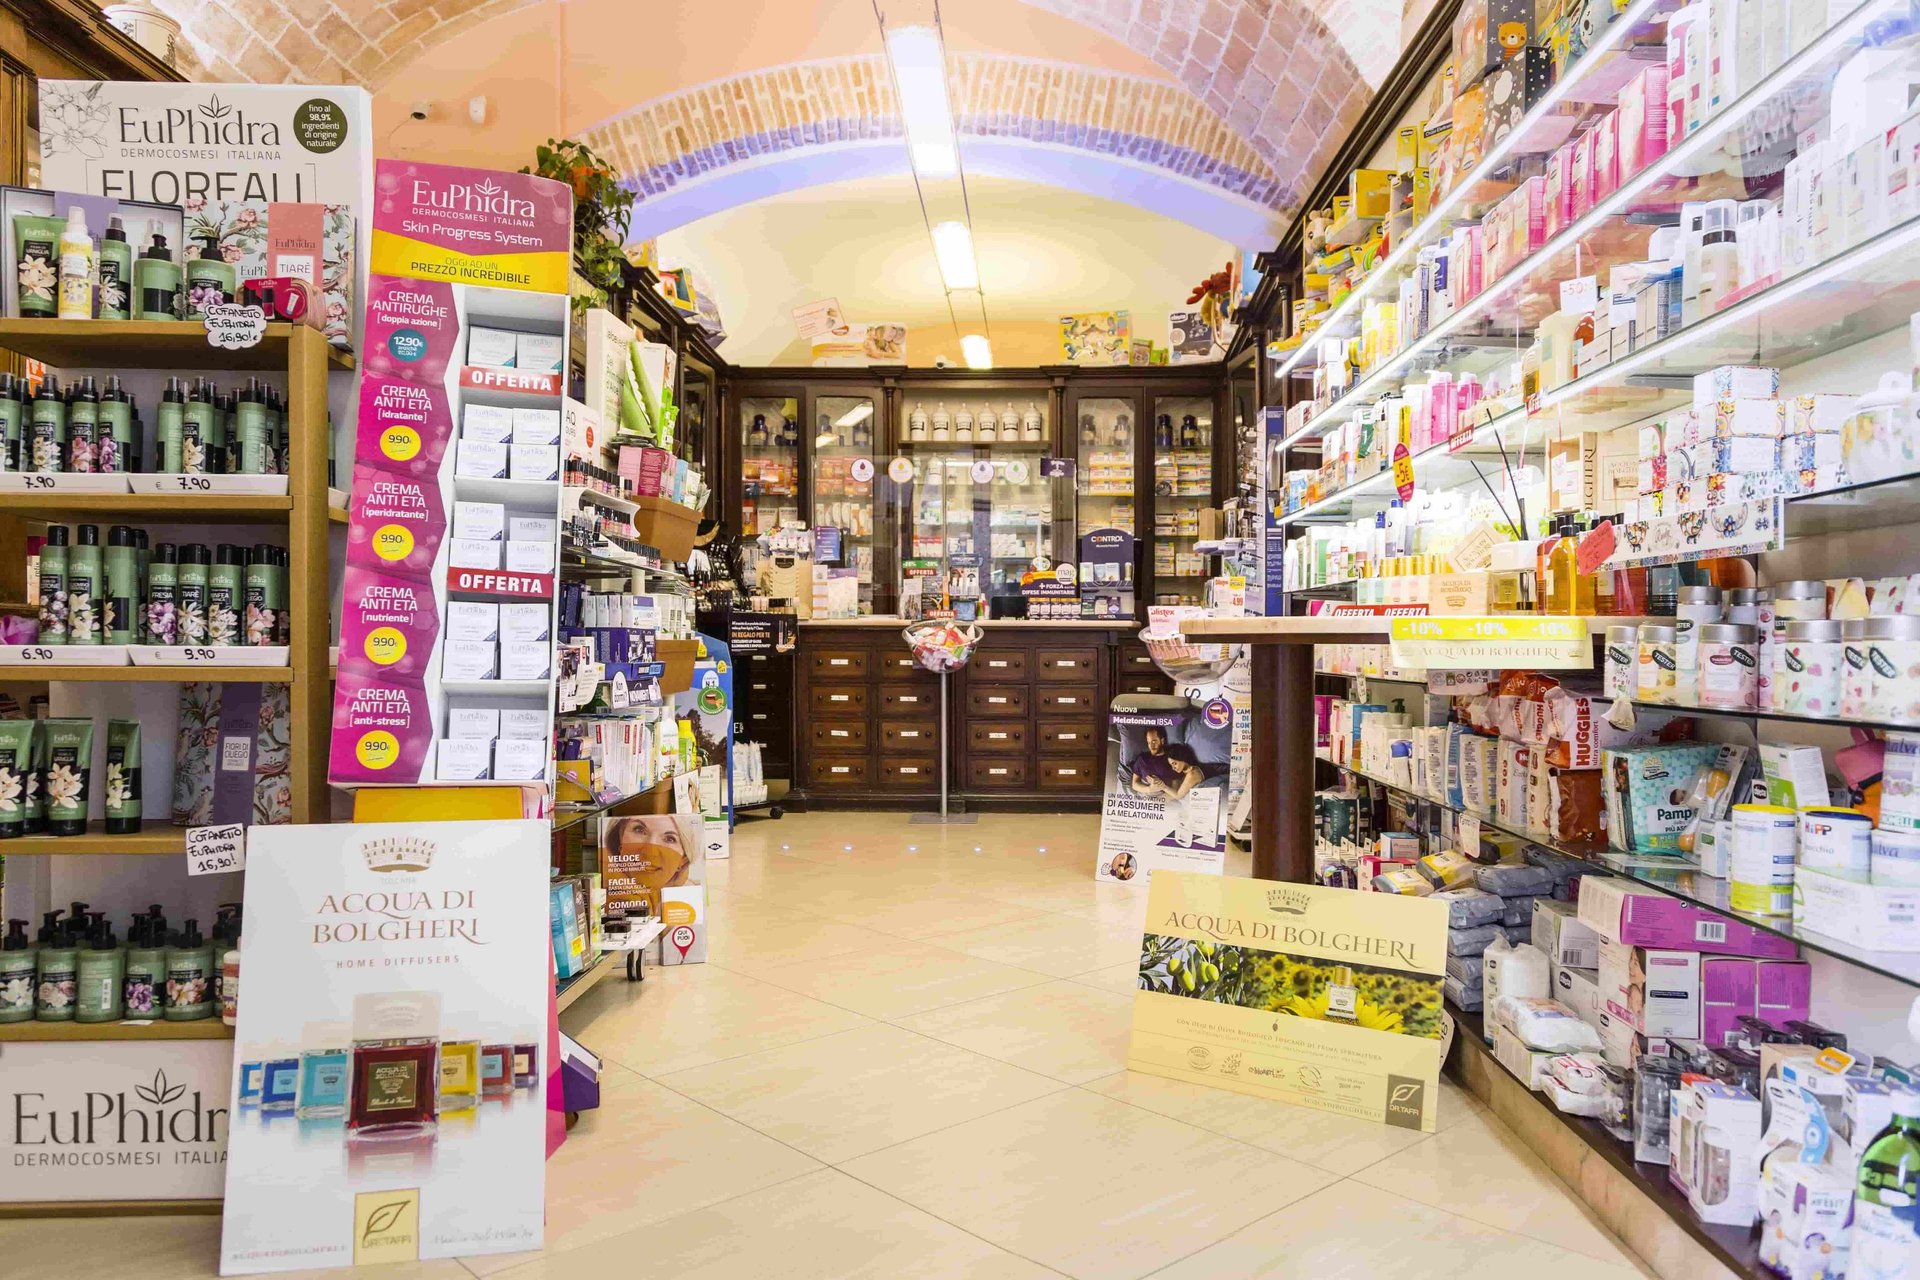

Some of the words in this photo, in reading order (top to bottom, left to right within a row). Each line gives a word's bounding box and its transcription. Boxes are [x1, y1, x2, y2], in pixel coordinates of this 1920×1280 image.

[118, 106, 281, 146] EuPhidra
[302, 122, 339, 131] ingredienti
[313, 131, 337, 140] origine
[121, 148, 219, 159] DERMOCOSMESI
[228, 150, 281, 161] ITALIANA
[412, 180, 536, 218] EuPhidra
[412, 207, 488, 222] DERMOCOSMESI
[493, 216, 535, 228] ITALIANA
[402, 220, 430, 233] Skin
[433, 224, 492, 241] Progress
[495, 230, 543, 247] System
[279, 263, 311, 274] TIARÈ
[411, 261, 457, 276] PREZZO
[460, 268, 531, 285] INCREDIBILE
[388, 291, 434, 305] CREMA
[372, 300, 448, 318] ANTIRUGHE
[471, 370, 552, 391] OFFERTA
[381, 385, 427, 398] CREMA
[374, 397, 407, 409] ANTI
[374, 482, 420, 496] CREMA
[366, 495, 400, 505] ANTI
[459, 573, 543, 594] OFFERTA
[365, 586, 413, 599] CREMA
[358, 598, 392, 610] ANTI
[1334, 608, 1374, 616] OFFERTA
[1384, 608, 1428, 616] OFFERTA
[1402, 622, 1444, 636] -10%
[1468, 622, 1507, 636] -10%
[1609, 647, 1631, 665] TESTER
[1733, 649, 1754, 666] TESTER
[357, 689, 406, 701] CREMA
[351, 701, 384, 713] ANTI
[1113, 705, 1138, 714] Nuova
[1113, 716, 1156, 725] Melatonina
[1156, 718, 1173, 726] IBSA
[1576, 698, 1591, 766] HUGGIES
[1118, 801, 1165, 812] ASSUMERE
[1117, 810, 1164, 820] MELATONINA
[1804, 821, 1832, 835] HiPP
[608, 854, 640, 863] VELOCE
[609, 878, 636, 886] FACILE
[317, 892, 433, 920] ACQUA
[442, 890, 474, 910] DI
[312, 917, 492, 945] BOLGHERI
[1164, 911, 1245, 941] ACQUA
[1252, 922, 1277, 941] DI
[1283, 926, 1425, 968] BOLGHERI
[336, 958, 375, 969] HOME
[384, 955, 461, 967] DIFFUSERS
[13, 1091, 231, 1144] EuPhidr
[14, 1151, 161, 1167] DERMOCOSMESI
